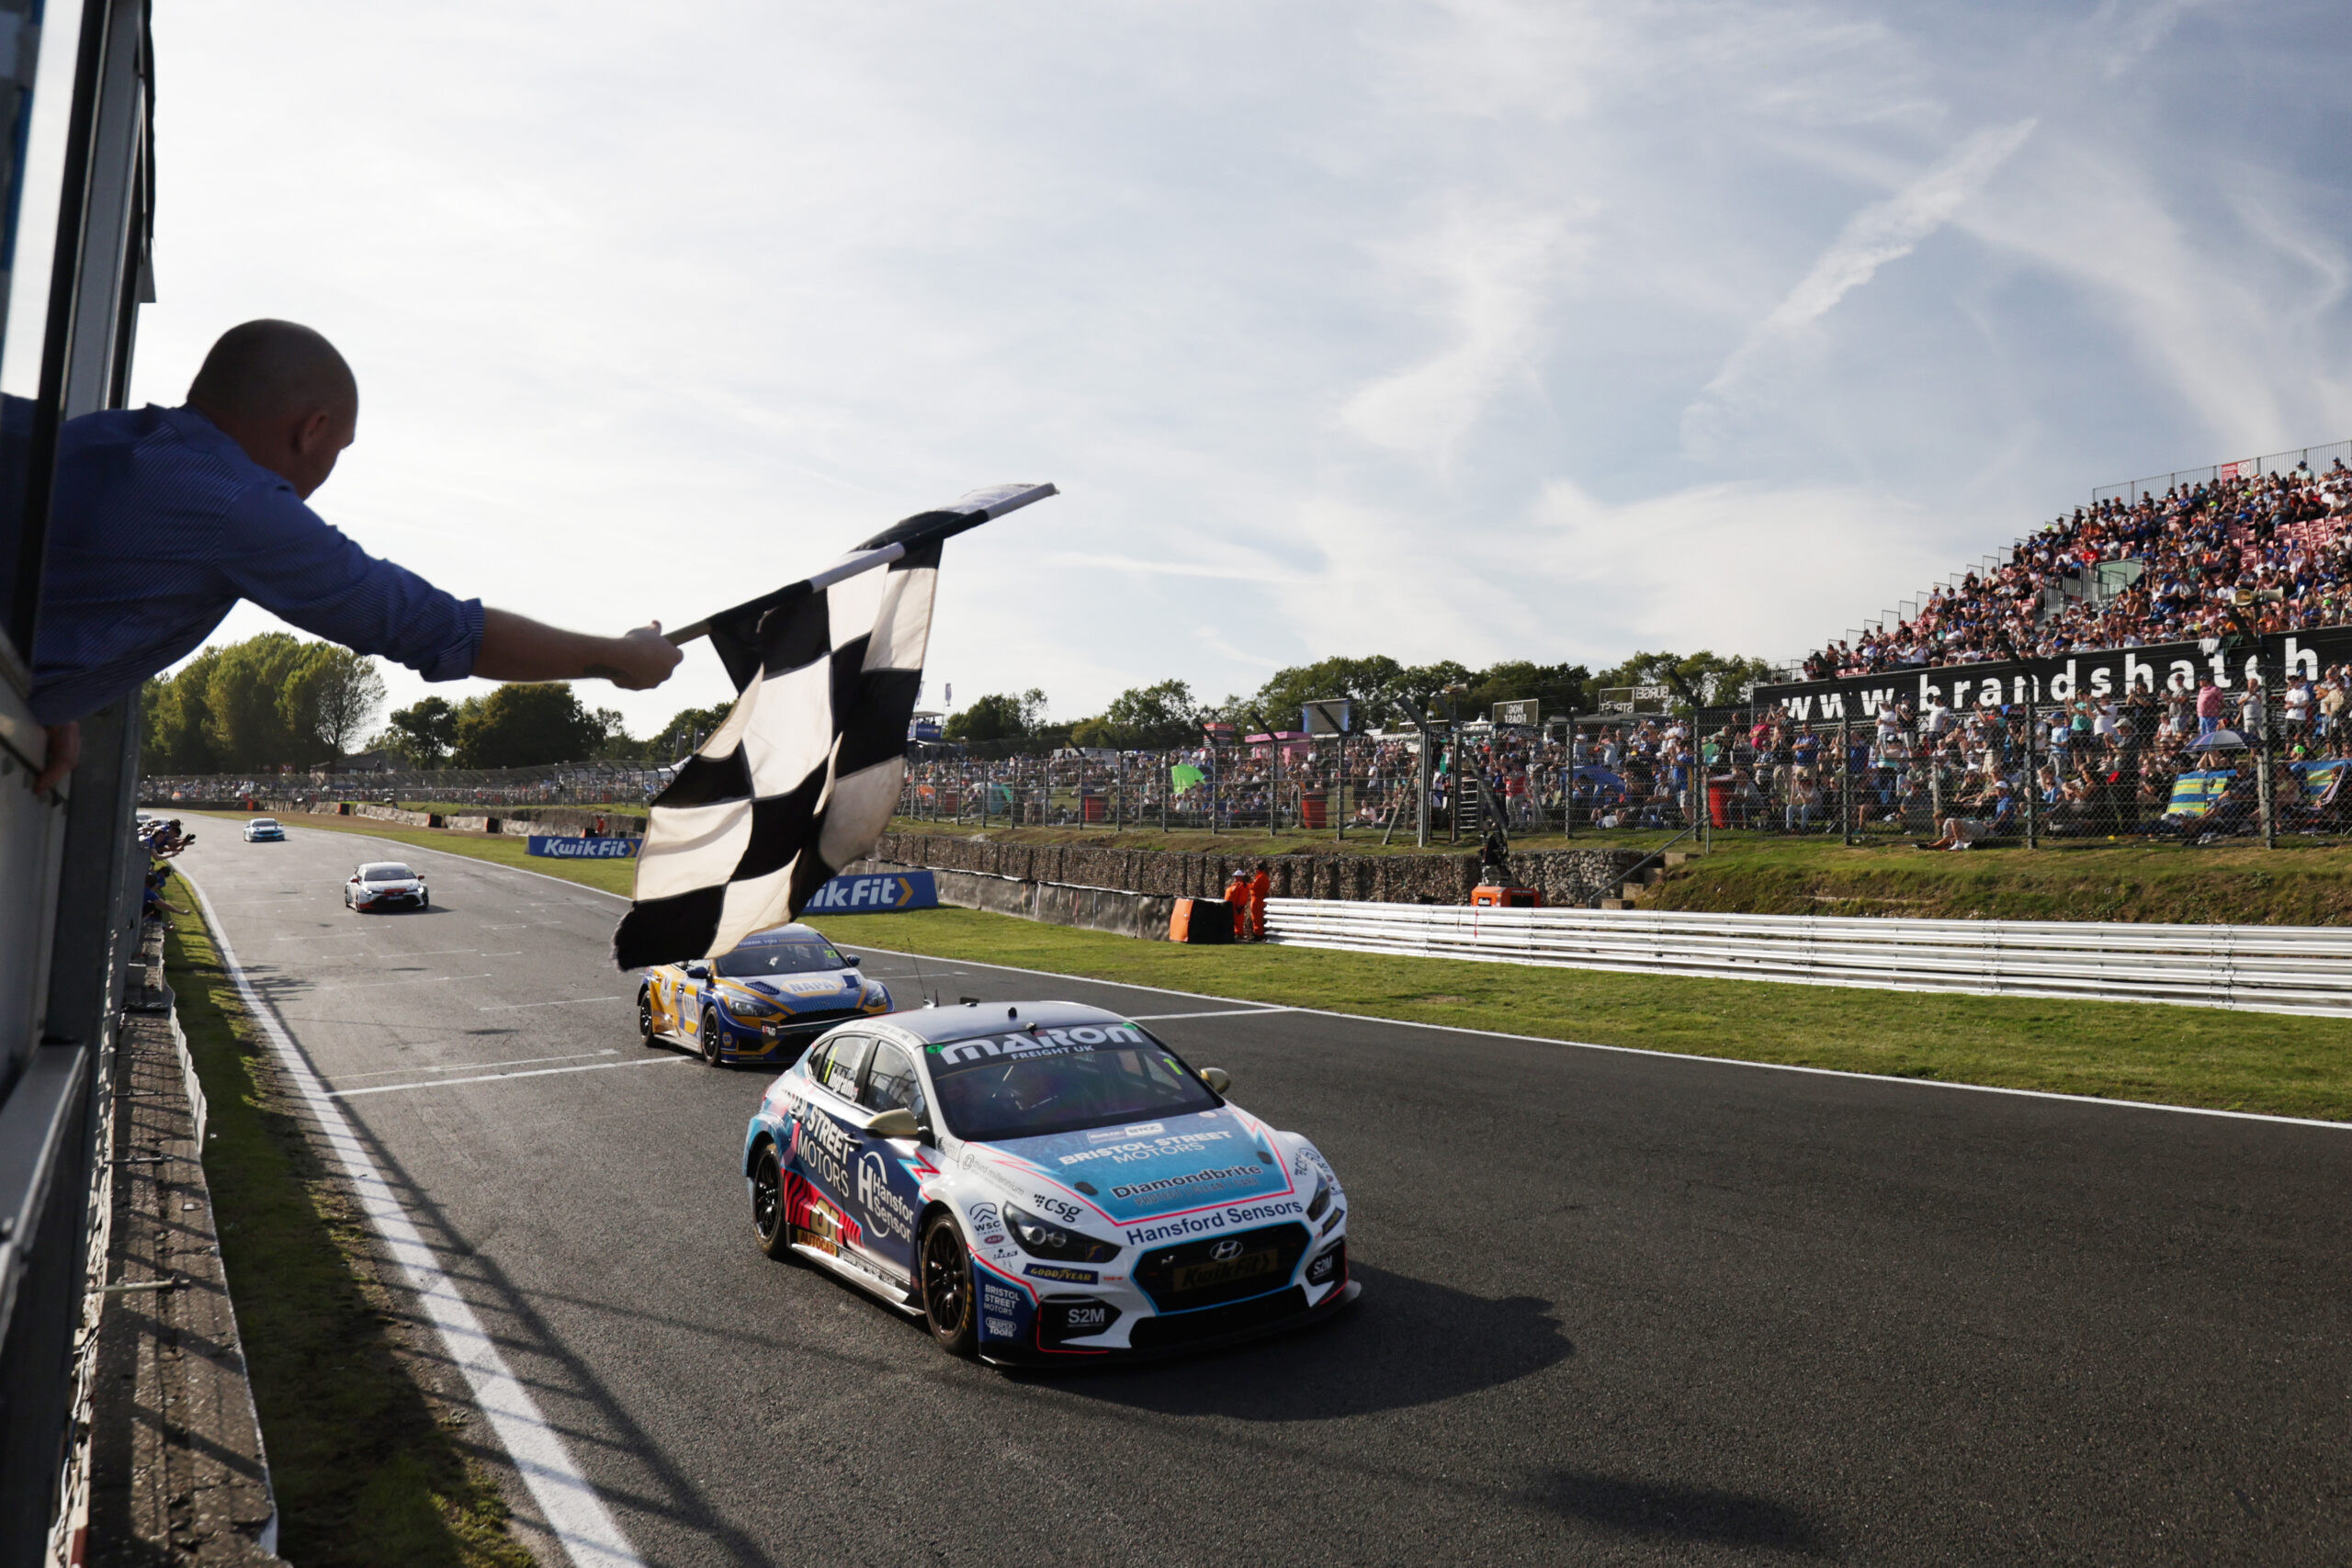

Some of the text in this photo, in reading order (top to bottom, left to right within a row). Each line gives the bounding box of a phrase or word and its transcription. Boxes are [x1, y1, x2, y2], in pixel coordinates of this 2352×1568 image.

[788, 981, 836, 992] NAPA
[1012, 1044, 1095, 1061] FREIGHT UK
[807, 1105, 850, 1165] STREET
[1058, 1131, 1233, 1165] BRISTOL STREET
[1113, 1142, 1206, 1164] MOTORS
[798, 1130, 850, 1198] MOTORS
[1111, 1165, 1263, 1199] Diamondbrite
[975, 1220, 1001, 1232] WSC
[1126, 1212, 1226, 1246] Hansford
[1227, 1201, 1304, 1224] Sensors
[800, 1230, 836, 1256] AUTOCAR
[1313, 1255, 1332, 1275] S2M
[984, 1284, 1020, 1302] BRISTOL
[984, 1292, 1017, 1309] STREET
[984, 1303, 1013, 1316] MOTORS
[1068, 1308, 1105, 1324] S2M
[989, 1326, 1014, 1337] Tools
